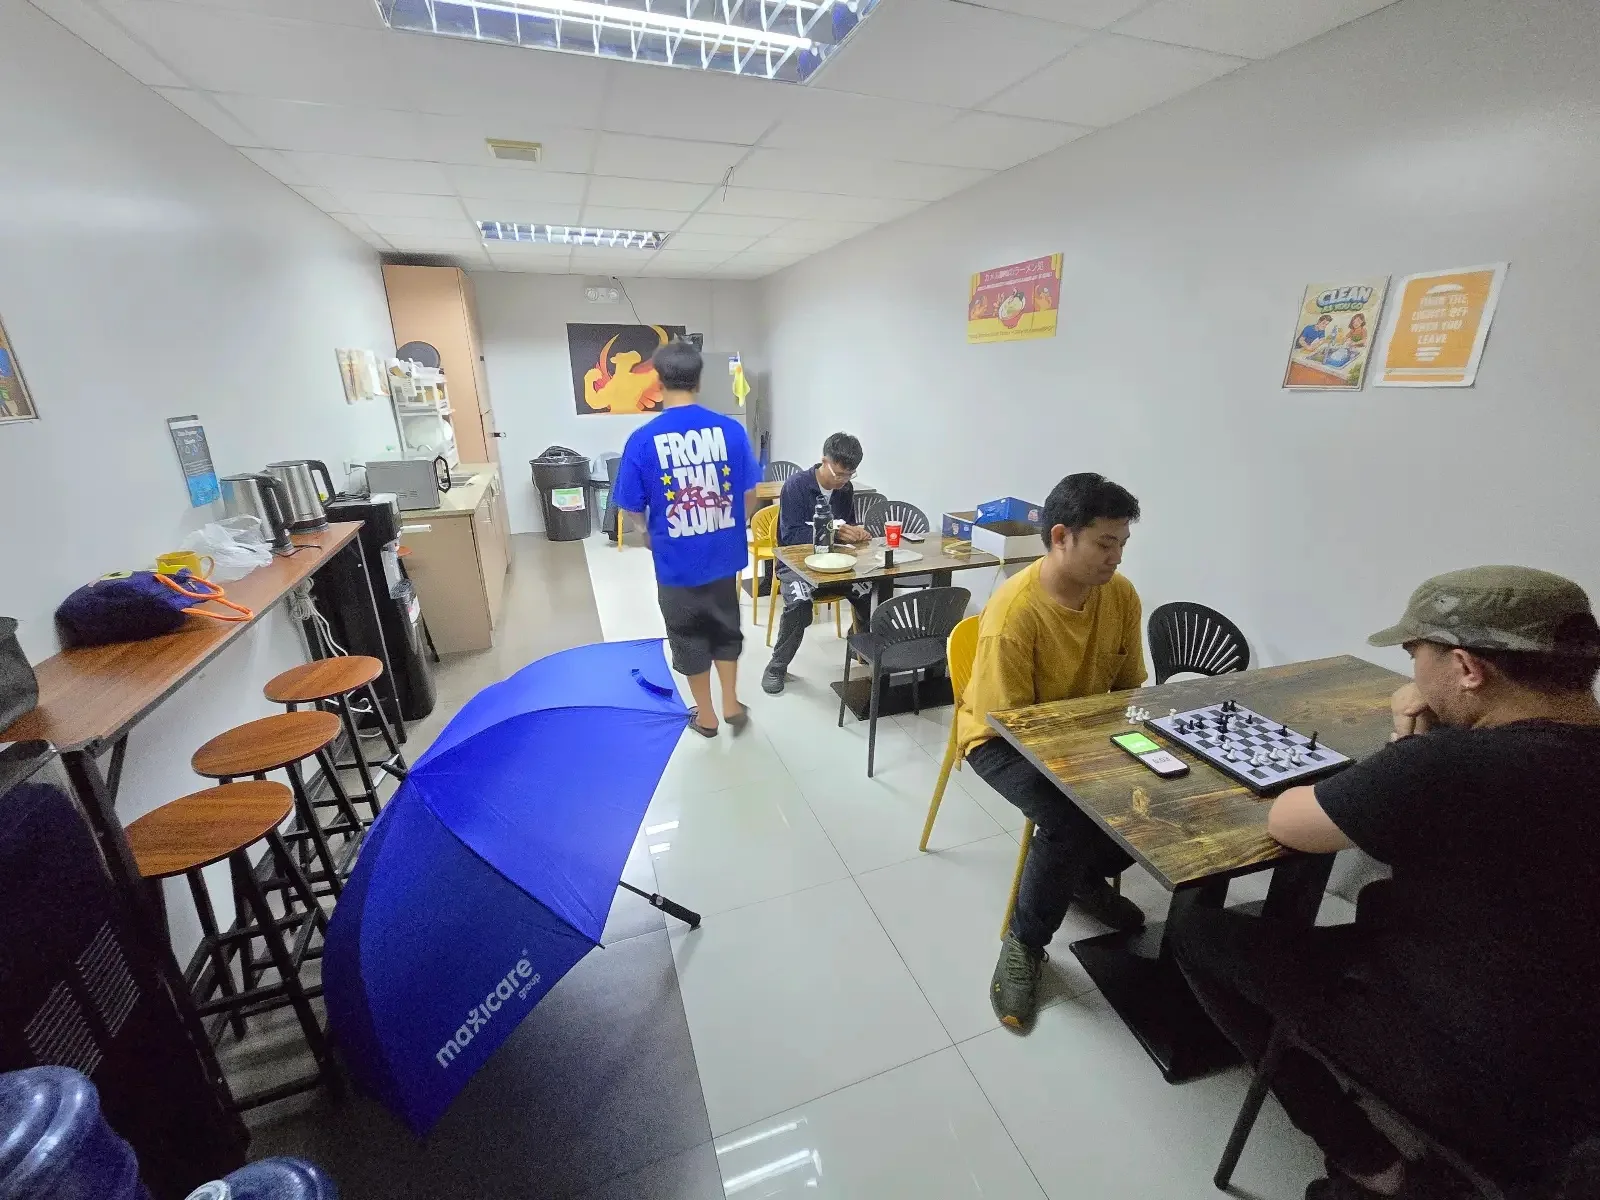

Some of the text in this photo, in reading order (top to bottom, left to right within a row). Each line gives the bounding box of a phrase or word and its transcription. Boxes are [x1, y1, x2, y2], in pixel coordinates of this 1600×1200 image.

[1316, 286, 1373, 307] CLEAN
[1418, 333, 1448, 344] LEAVE
[653, 427, 728, 470] FROM
[672, 463, 721, 497] THA
[665, 495, 736, 538] SLUMZ
[518, 973, 541, 1001] group
[435, 958, 533, 1069] maxicare
